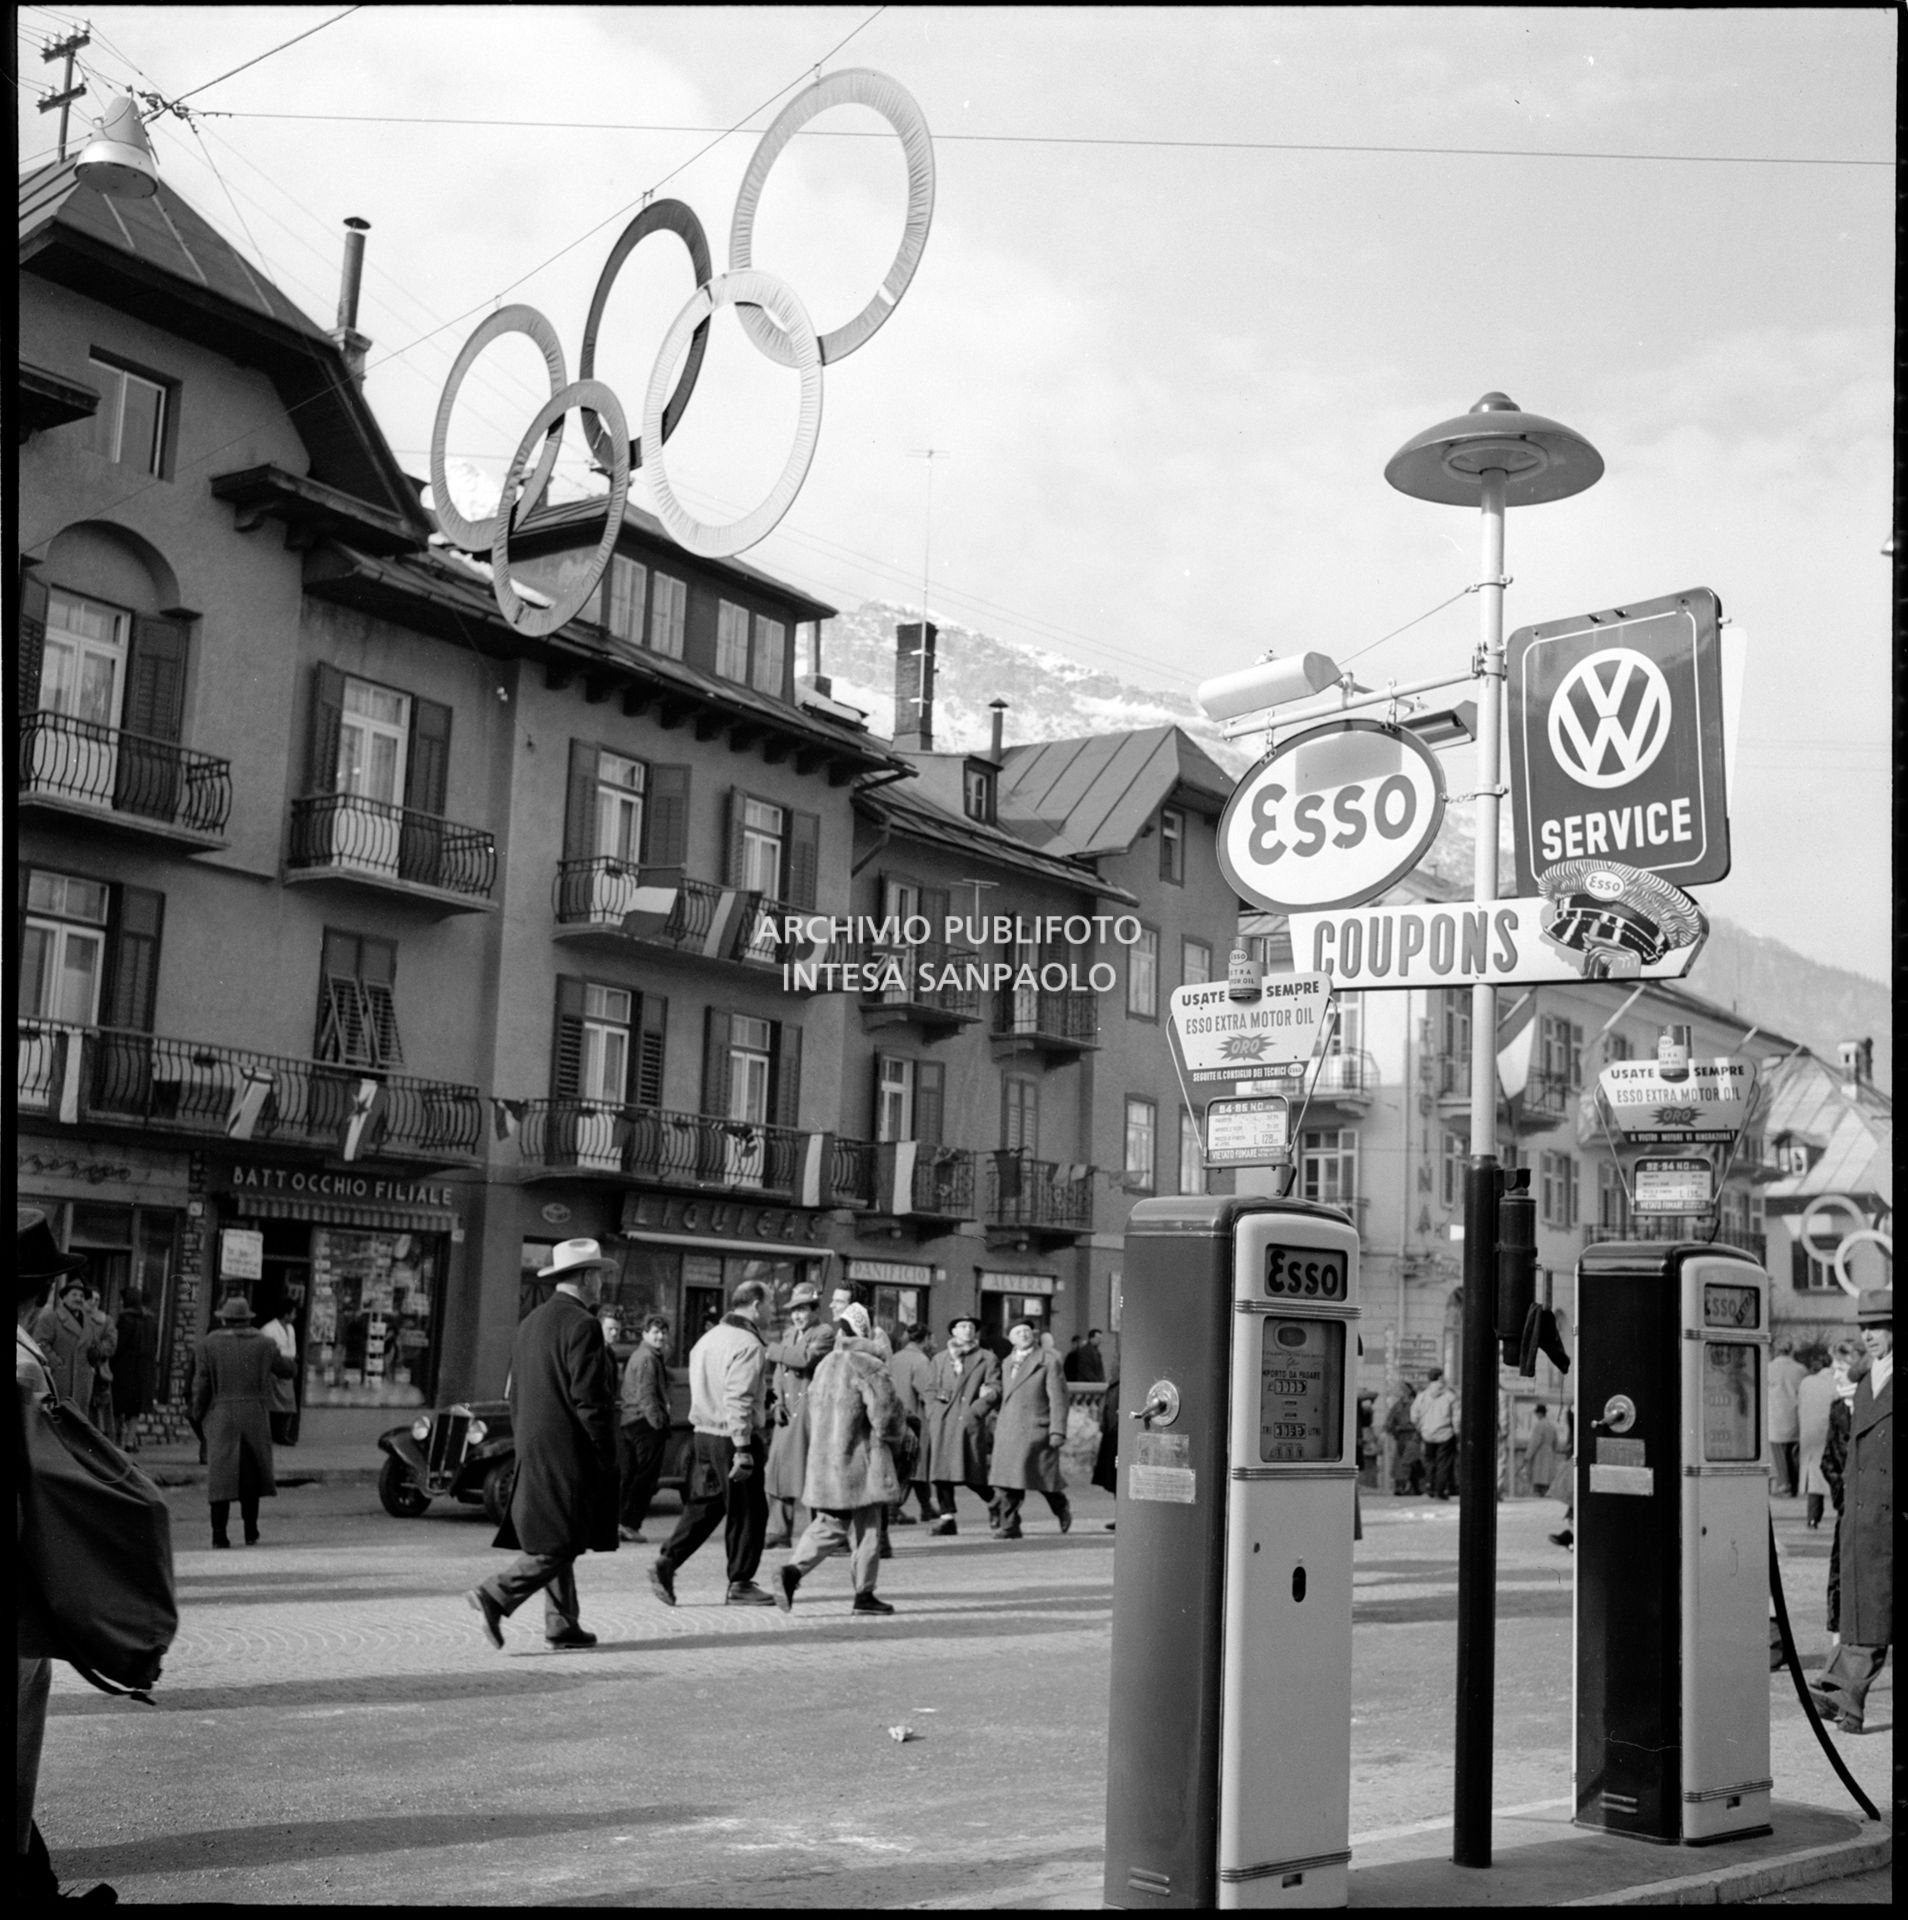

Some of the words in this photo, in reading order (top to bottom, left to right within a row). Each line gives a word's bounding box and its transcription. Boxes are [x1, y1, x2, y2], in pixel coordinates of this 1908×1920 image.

[1541, 797, 1692, 860] SERVICE
[1313, 908, 1519, 978] COUPONS
[1182, 990, 1225, 1006] USATE
[1266, 981, 1319, 998] SEMPRE
[1186, 1018, 1212, 1035] ESSO
[1215, 1014, 1247, 1032] EXTRA
[1251, 1010, 1291, 1028] MOTOR
[1296, 1007, 1314, 1025] OIL
[1231, 1038, 1261, 1055] ORO
[1193, 1071, 1216, 1082] SEGUITE
[1223, 1068, 1252, 1080] CONSIGLIO
[1264, 1066, 1287, 1077] TECNICI
[1611, 1068, 1654, 1079] USATE
[1694, 1065, 1744, 1077] SEMPRE
[1617, 1089, 1642, 1103] ESSO
[1646, 1088, 1676, 1102] EXTRA
[1680, 1087, 1719, 1102] MOTOR
[1723, 1086, 1741, 1101] OIL
[1663, 1109, 1692, 1121] ORO
[233, 1166, 367, 1198] BATTOCCHIO
[375, 1180, 453, 1205] FILIALE
[634, 1196, 820, 1240] LIQUIGAS
[854, 1262, 926, 1281] PANIFICIO
[1299, 1371, 1321, 1380] PAGARE
